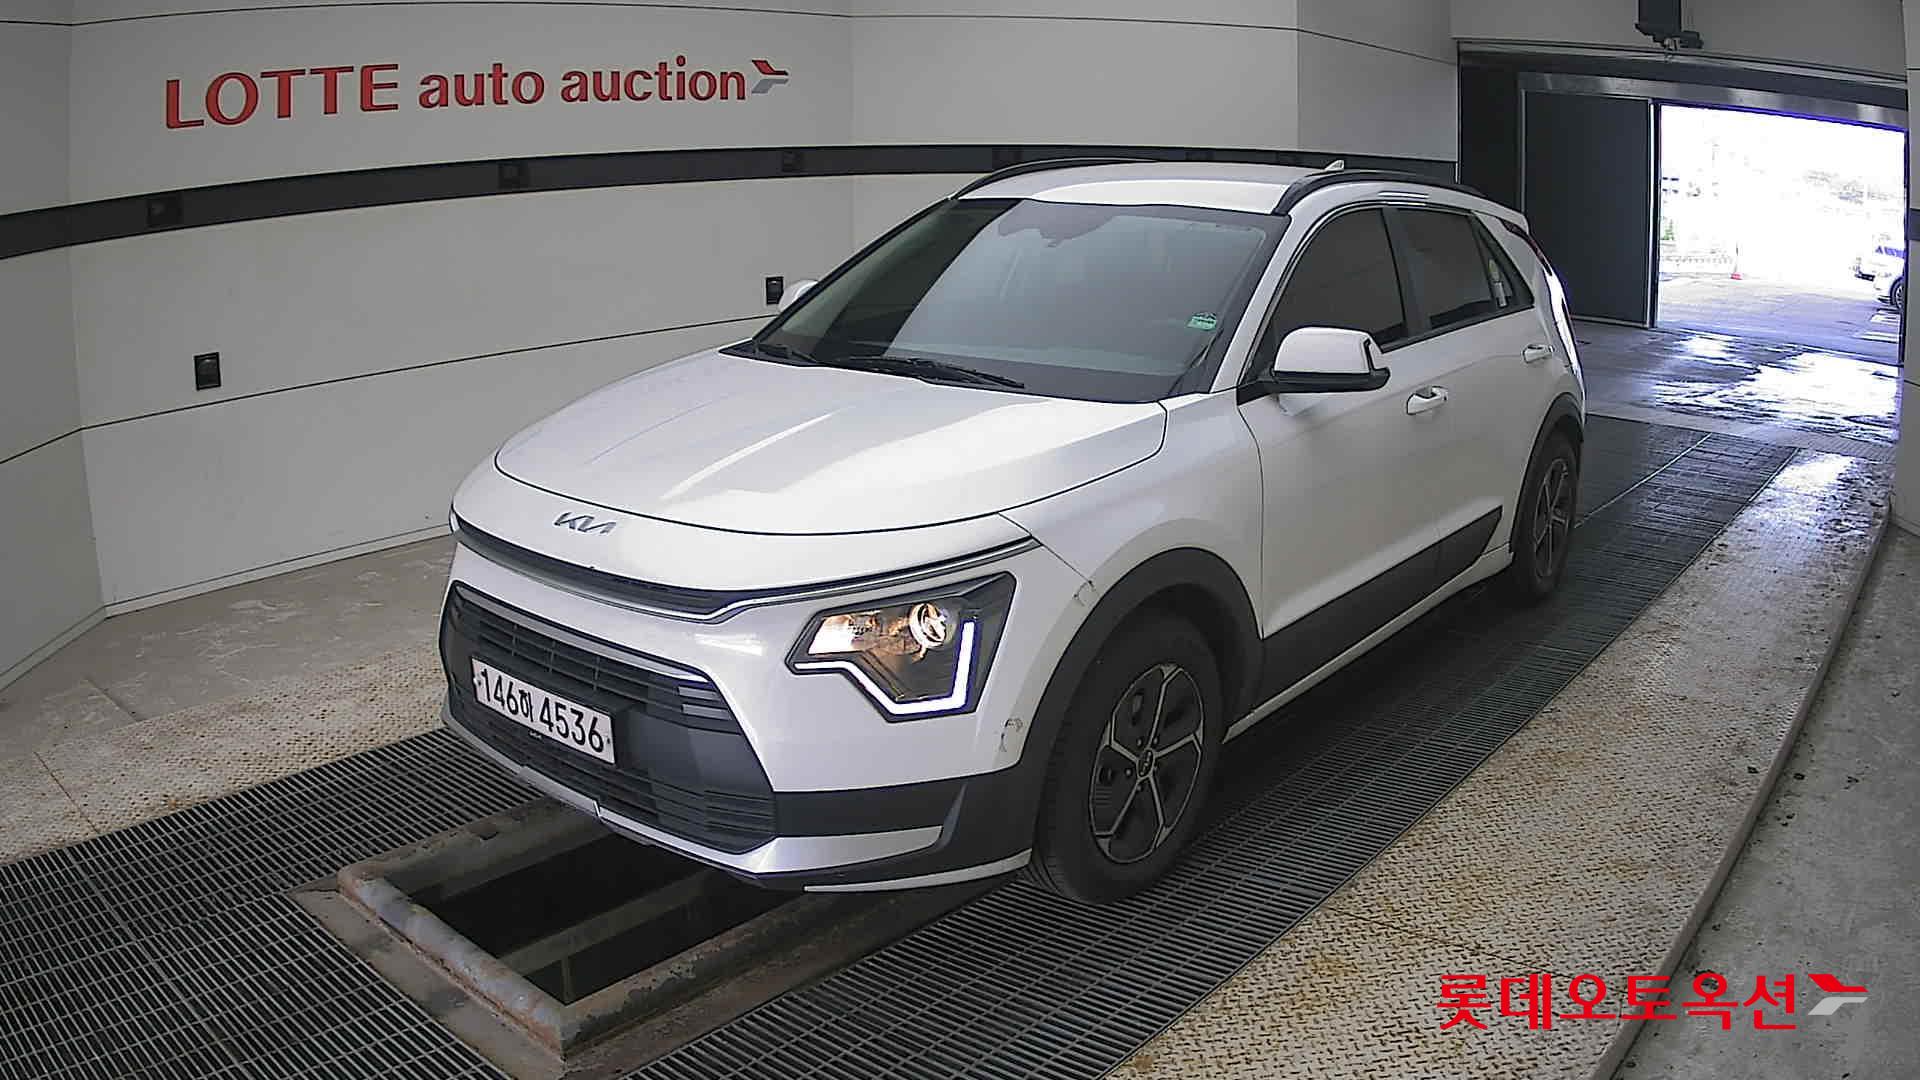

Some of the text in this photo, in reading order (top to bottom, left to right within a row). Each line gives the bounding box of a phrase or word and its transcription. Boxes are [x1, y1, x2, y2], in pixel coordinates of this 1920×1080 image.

[165, 54, 748, 130] LOTTE auto auction
[553, 511, 617, 535] KIA
[539, 696, 604, 753] 4536
